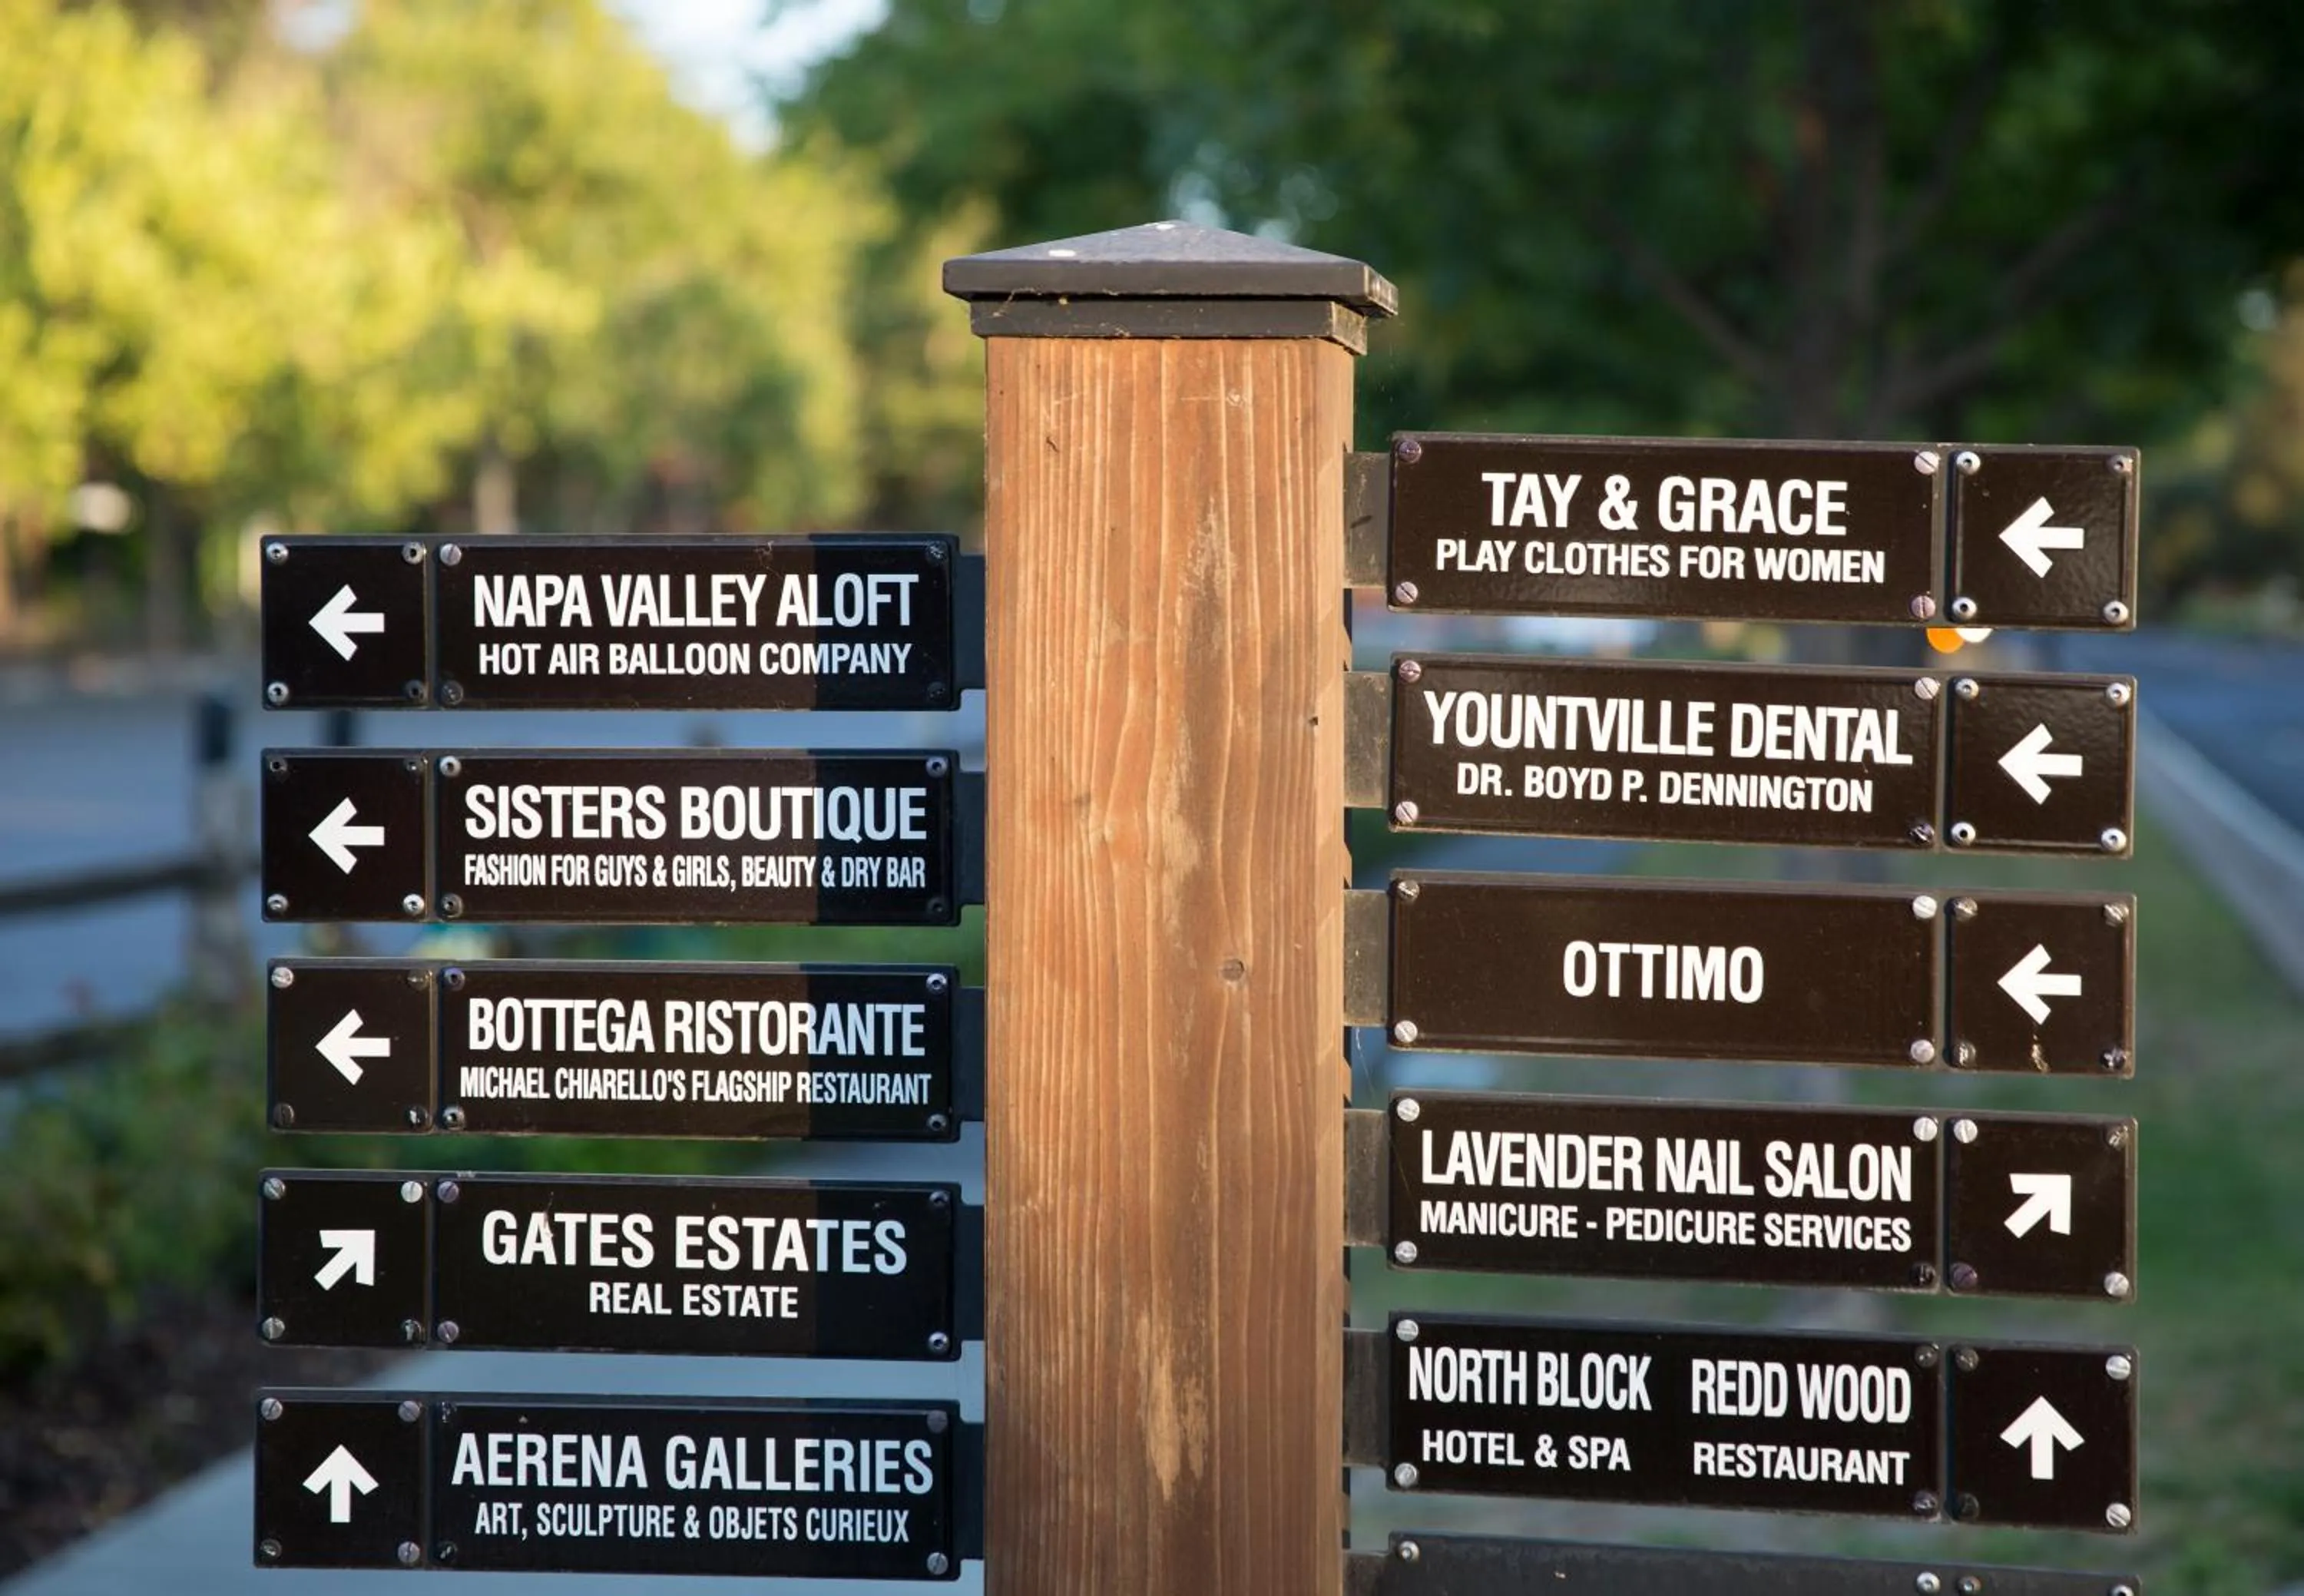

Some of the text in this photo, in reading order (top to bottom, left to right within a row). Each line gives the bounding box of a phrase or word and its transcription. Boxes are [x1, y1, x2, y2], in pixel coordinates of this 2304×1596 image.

[1481, 473, 1847, 535] TAY & GRACE
[1437, 539, 1885, 583] PLAY CLOTHES FOR WOMEN
[475, 573, 919, 627] NAPA VALLEY ALOFT
[480, 643, 911, 675] HOT AIR BALLOON COMPANY
[1423, 690, 1912, 765] YOUNTVILLE DENTAL
[465, 785, 926, 843] SISTERS BOUTIQUE
[1458, 762, 1872, 812] DR. BOYD P. DENNINGTON
[465, 854, 925, 892] FASHION FOR GUYS & GIRLS, BEAUTY & DRY BAR
[1564, 941, 1763, 1003] OTTIMO
[469, 998, 925, 1055] BOTTEGA RISTORANTE
[461, 1066, 931, 1104] MICHAEL CHIARELLO'S FLAGSHIP RESTAURANT
[1422, 1130, 1911, 1201] LAVENDER NAIL SALON
[483, 1210, 906, 1273] GATES ESTATES
[1421, 1200, 1577, 1238] MANICURE
[1607, 1207, 1756, 1245] PEDICURE
[1764, 1213, 1911, 1252] SERVICES
[590, 1282, 798, 1318] REAL ESTATE
[1409, 1346, 1651, 1410] NORTH BLOCK
[1693, 1359, 1911, 1422] REDD WOOD
[452, 1433, 932, 1493] AERENA GALLERIES
[1423, 1429, 1630, 1470] HOTEL & SPA
[1694, 1442, 1910, 1485] RESTAURANT
[475, 1502, 908, 1541] ART, SCULPTURE & OBJETS CURIEUX
